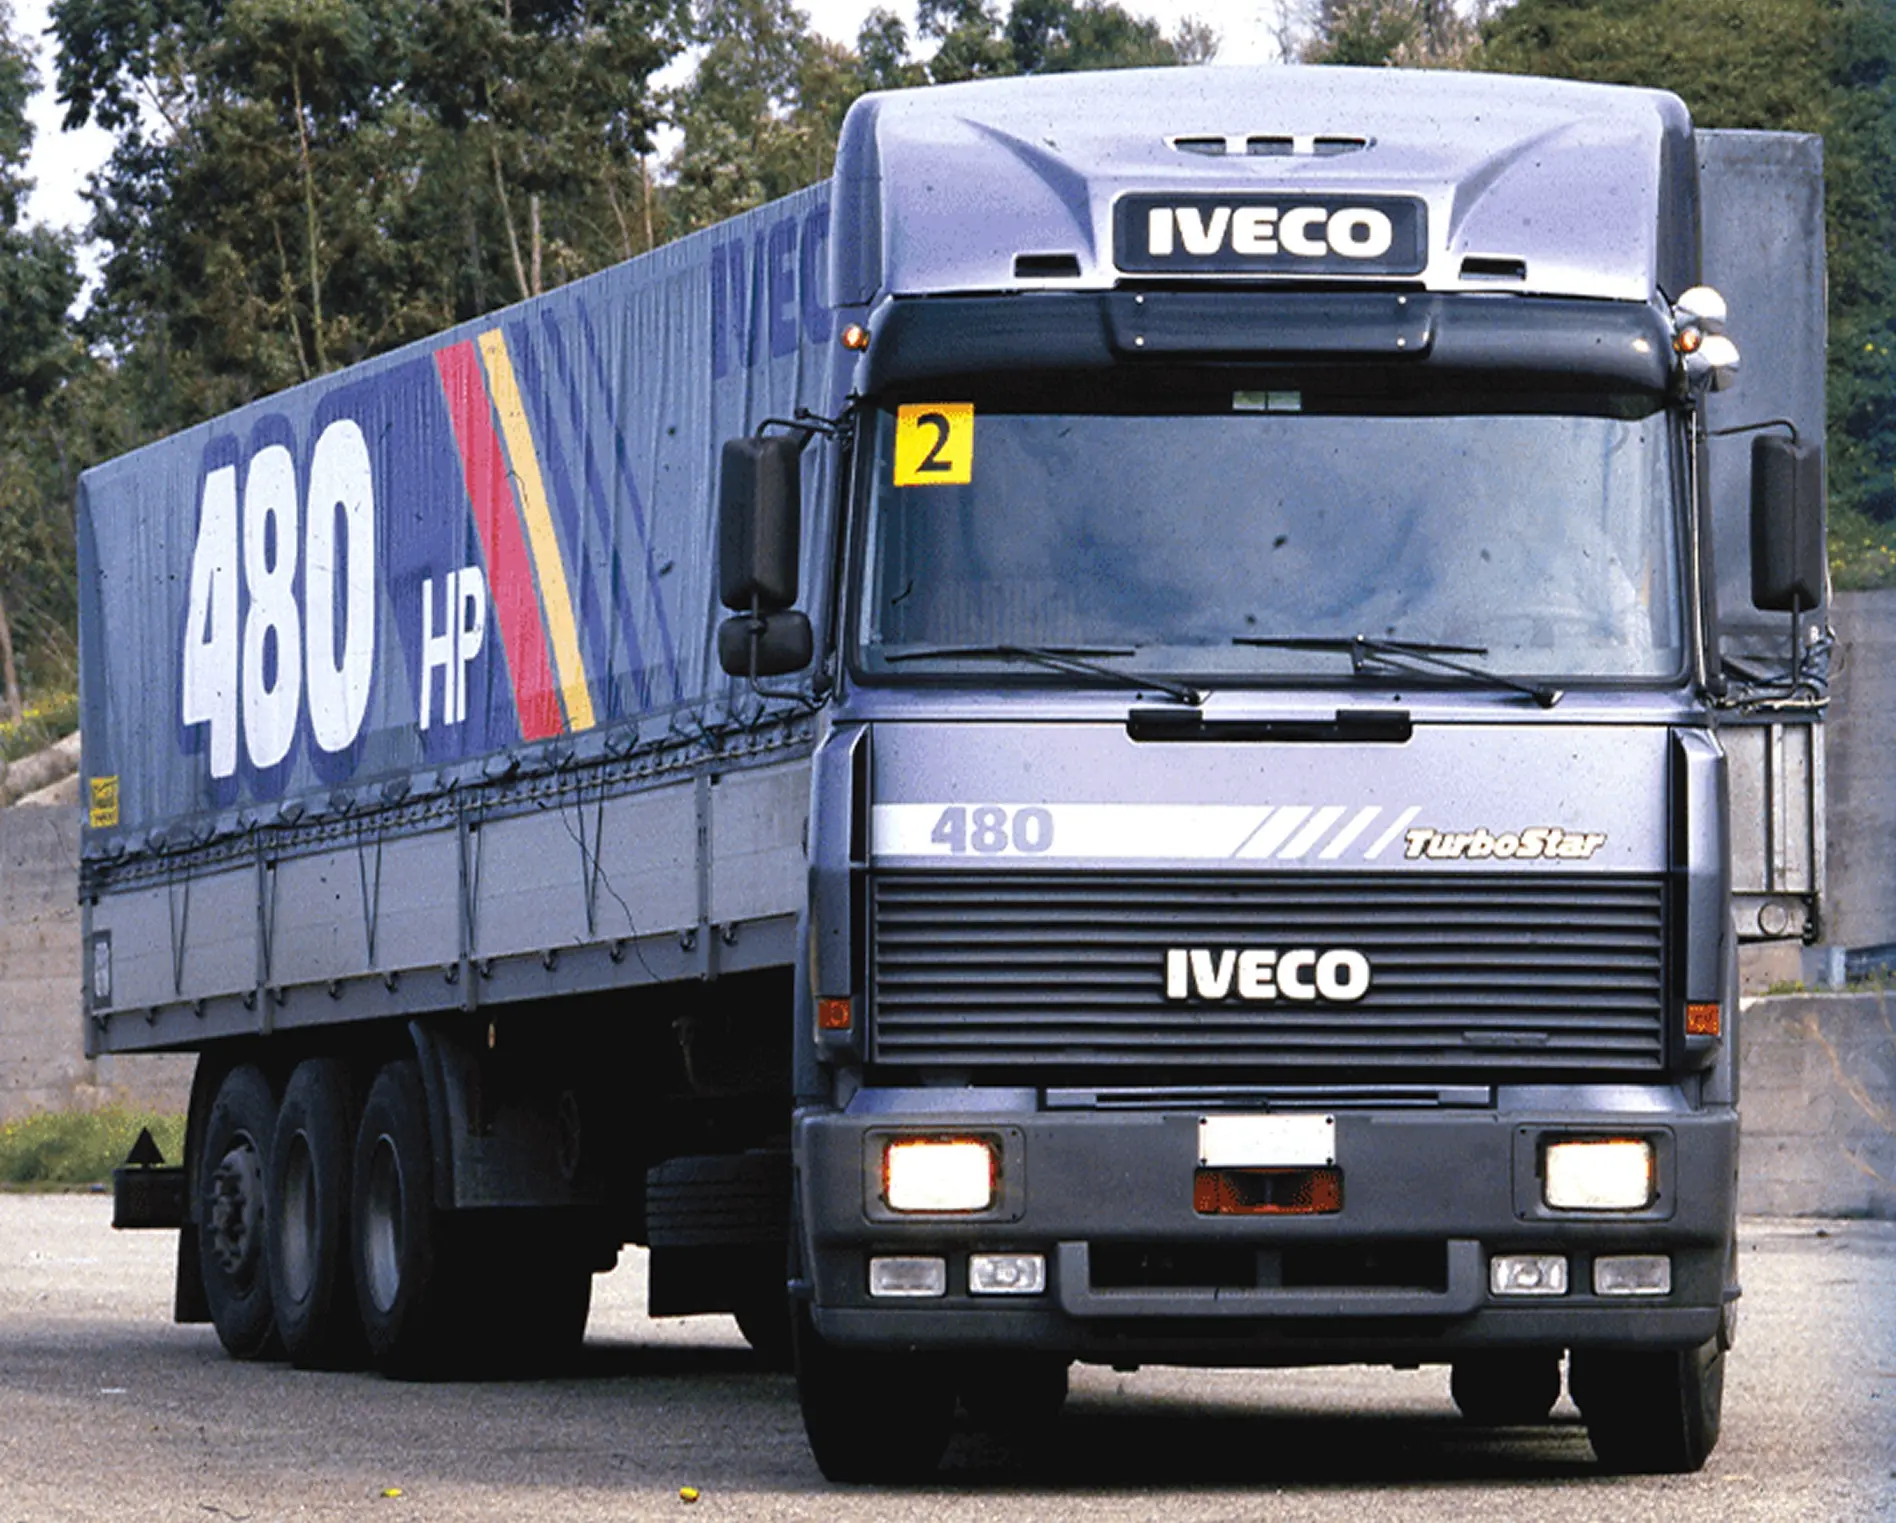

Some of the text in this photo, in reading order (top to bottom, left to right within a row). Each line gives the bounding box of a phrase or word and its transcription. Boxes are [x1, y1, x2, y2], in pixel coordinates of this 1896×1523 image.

[1149, 207, 1393, 258] IVECO
[915, 413, 953, 473] 2
[182, 418, 486, 779] 480 HP
[931, 806, 1053, 853] 480
[1404, 827, 1608, 860] TurboStar
[1167, 948, 1370, 1000] IVECO
